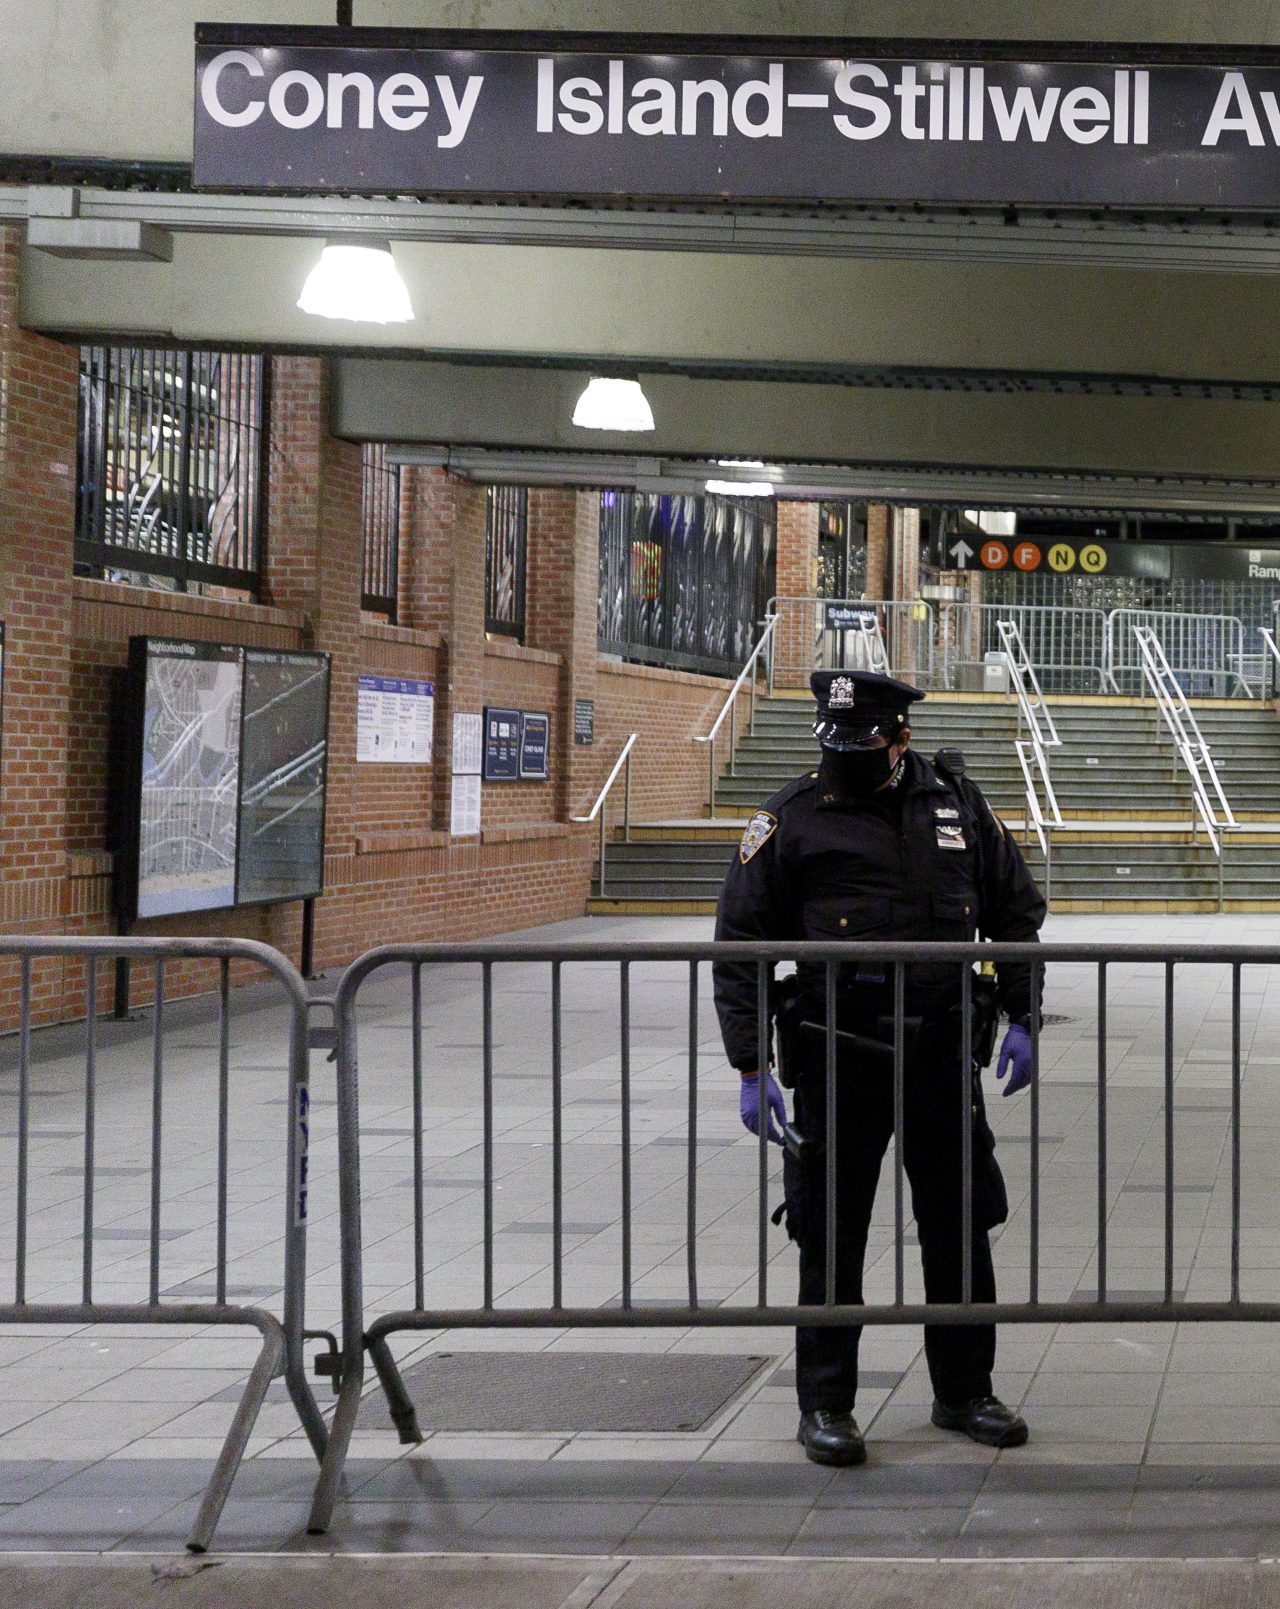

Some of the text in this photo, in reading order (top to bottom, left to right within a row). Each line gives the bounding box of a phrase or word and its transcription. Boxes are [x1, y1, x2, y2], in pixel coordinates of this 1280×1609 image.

[200, 50, 485, 149] Coney
[986, 547, 1102, 568] D F N Q
